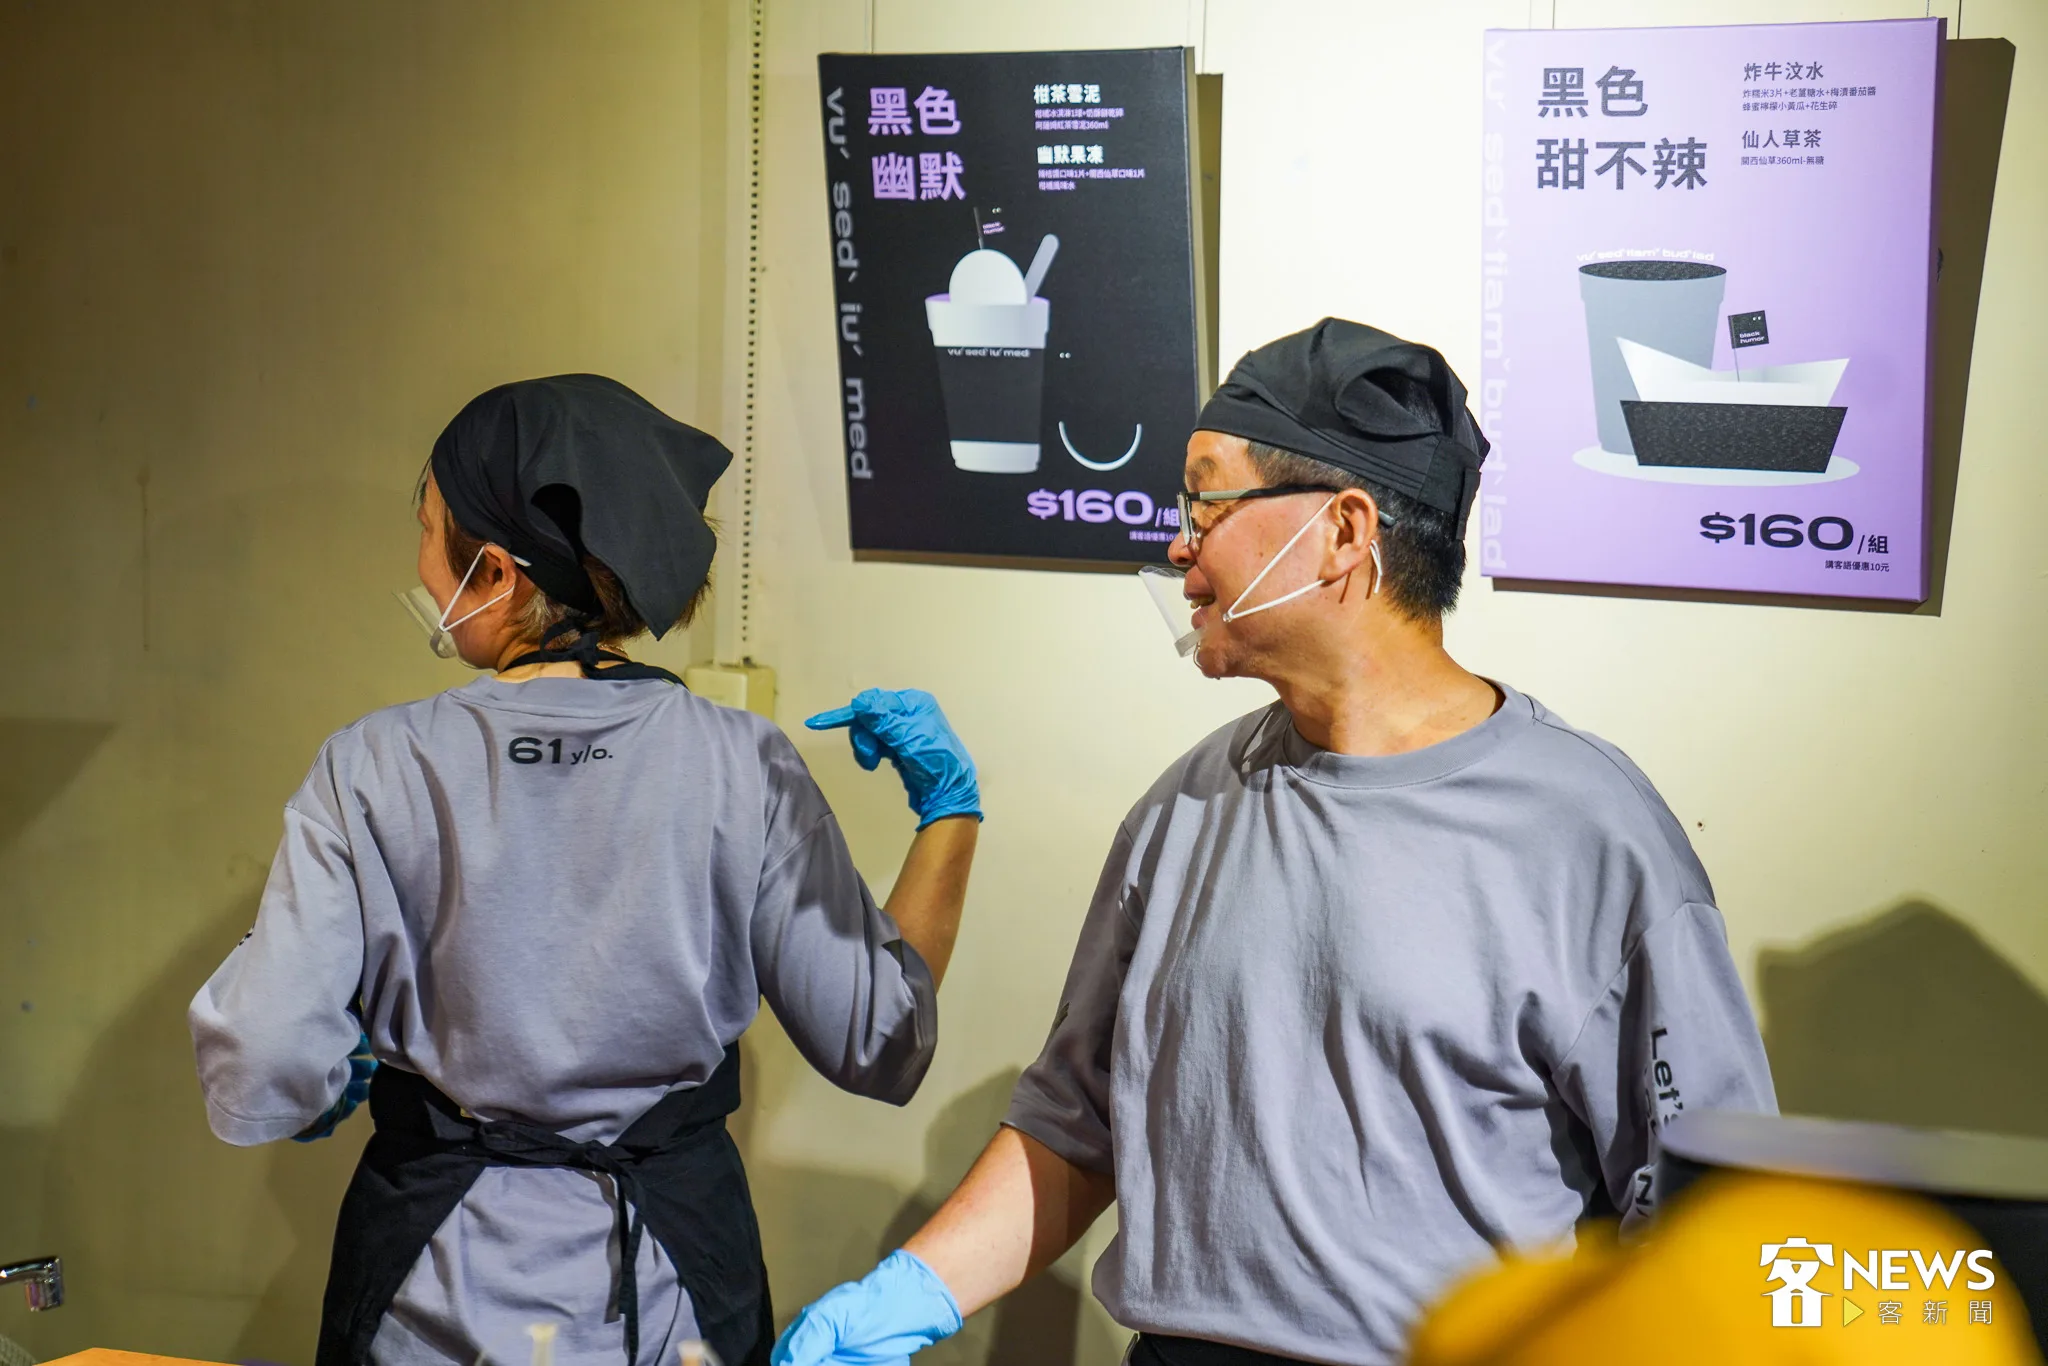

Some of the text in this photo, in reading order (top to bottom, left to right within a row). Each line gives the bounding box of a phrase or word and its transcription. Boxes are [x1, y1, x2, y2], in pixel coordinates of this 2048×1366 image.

[1743, 61, 1824, 81] 炸牛汶水
[1033, 84, 1101, 104] 柑茶雪泥
[1537, 65, 1648, 118] 黑色
[868, 86, 961, 136] 黑色
[1741, 129, 1821, 149] 仙人草茶
[1037, 145, 1104, 164] 幽默果凍
[1536, 137, 1708, 190] 甜不辣
[872, 151, 966, 201] 幽默
[1740, 331, 1760, 339] black
[1740, 336, 1765, 344] humor
[1004, 349, 1030, 358] med
[846, 378, 873, 479] med
[1484, 495, 1507, 569] lad
[1700, 511, 1889, 555] $160/組
[1825, 560, 1890, 572] 講客語優惠10元
[508, 736, 613, 765] 61 y/o.
[1651, 1027, 1683, 1126] Let'
